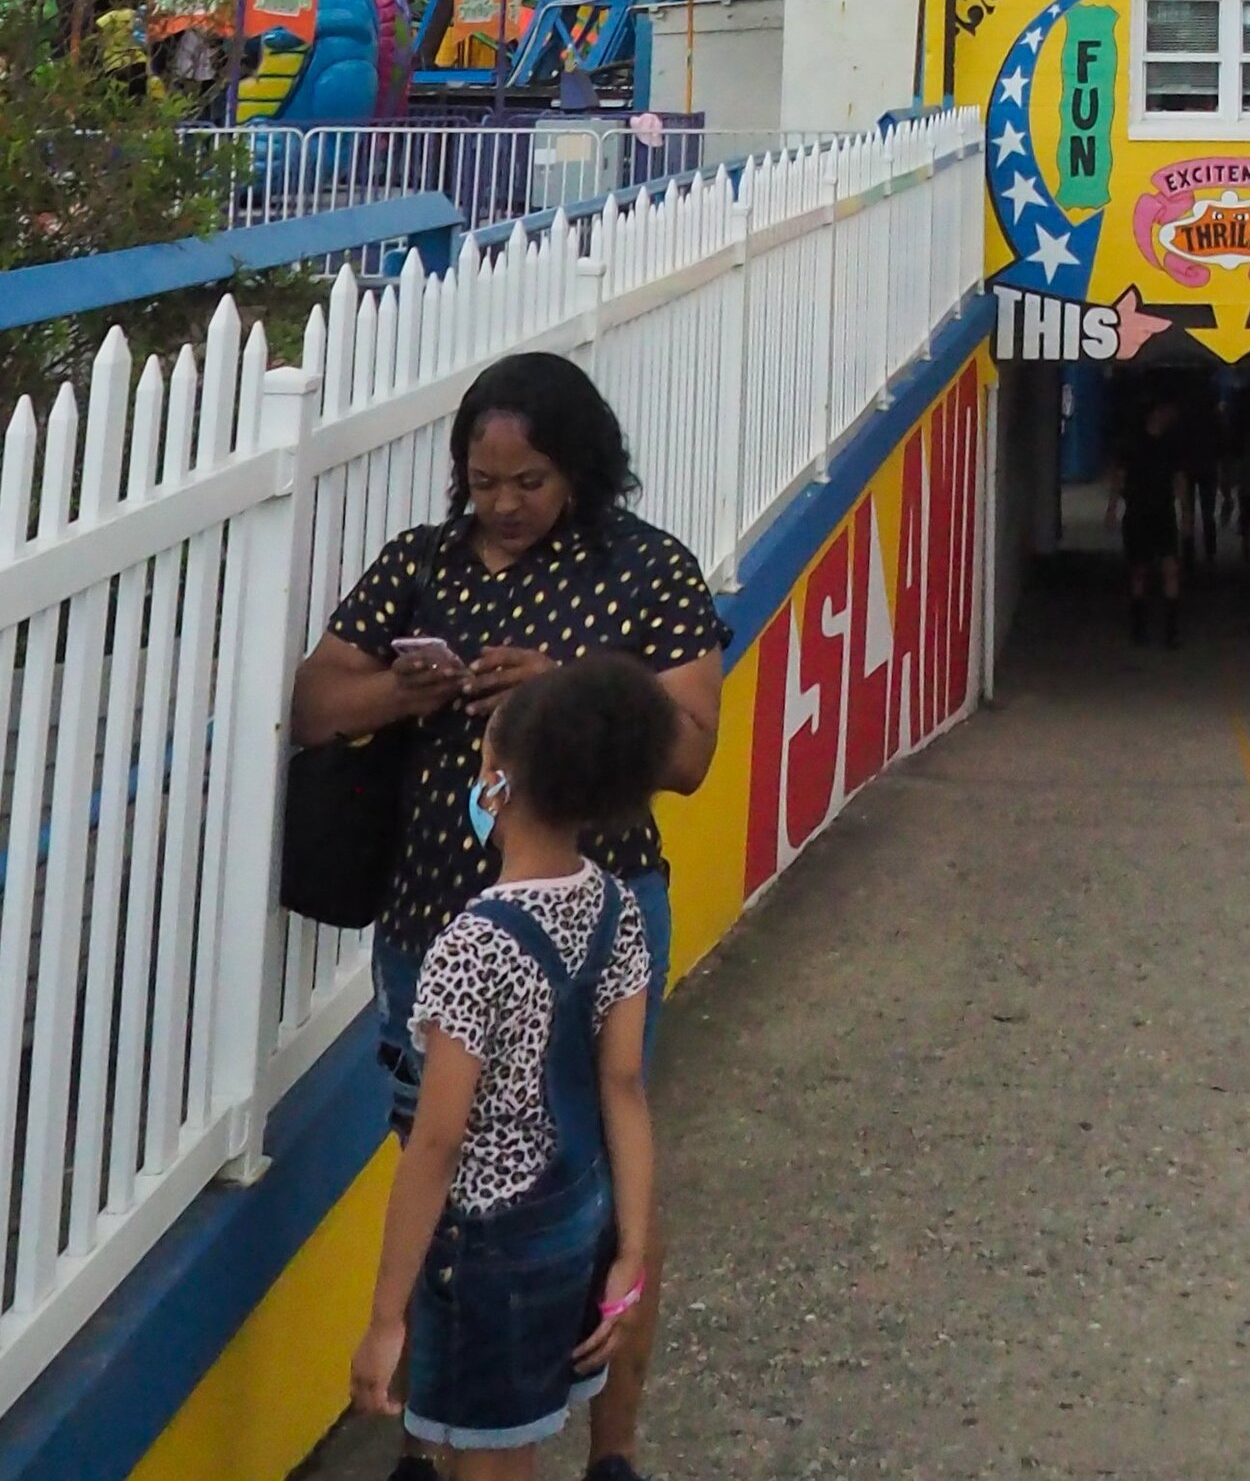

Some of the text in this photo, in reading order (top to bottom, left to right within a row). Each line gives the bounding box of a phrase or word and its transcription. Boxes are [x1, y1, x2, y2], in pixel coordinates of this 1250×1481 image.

[1070, 40, 1101, 177] FUN
[993, 285, 1120, 360] THIS
[744, 358, 979, 899] ISLAND
